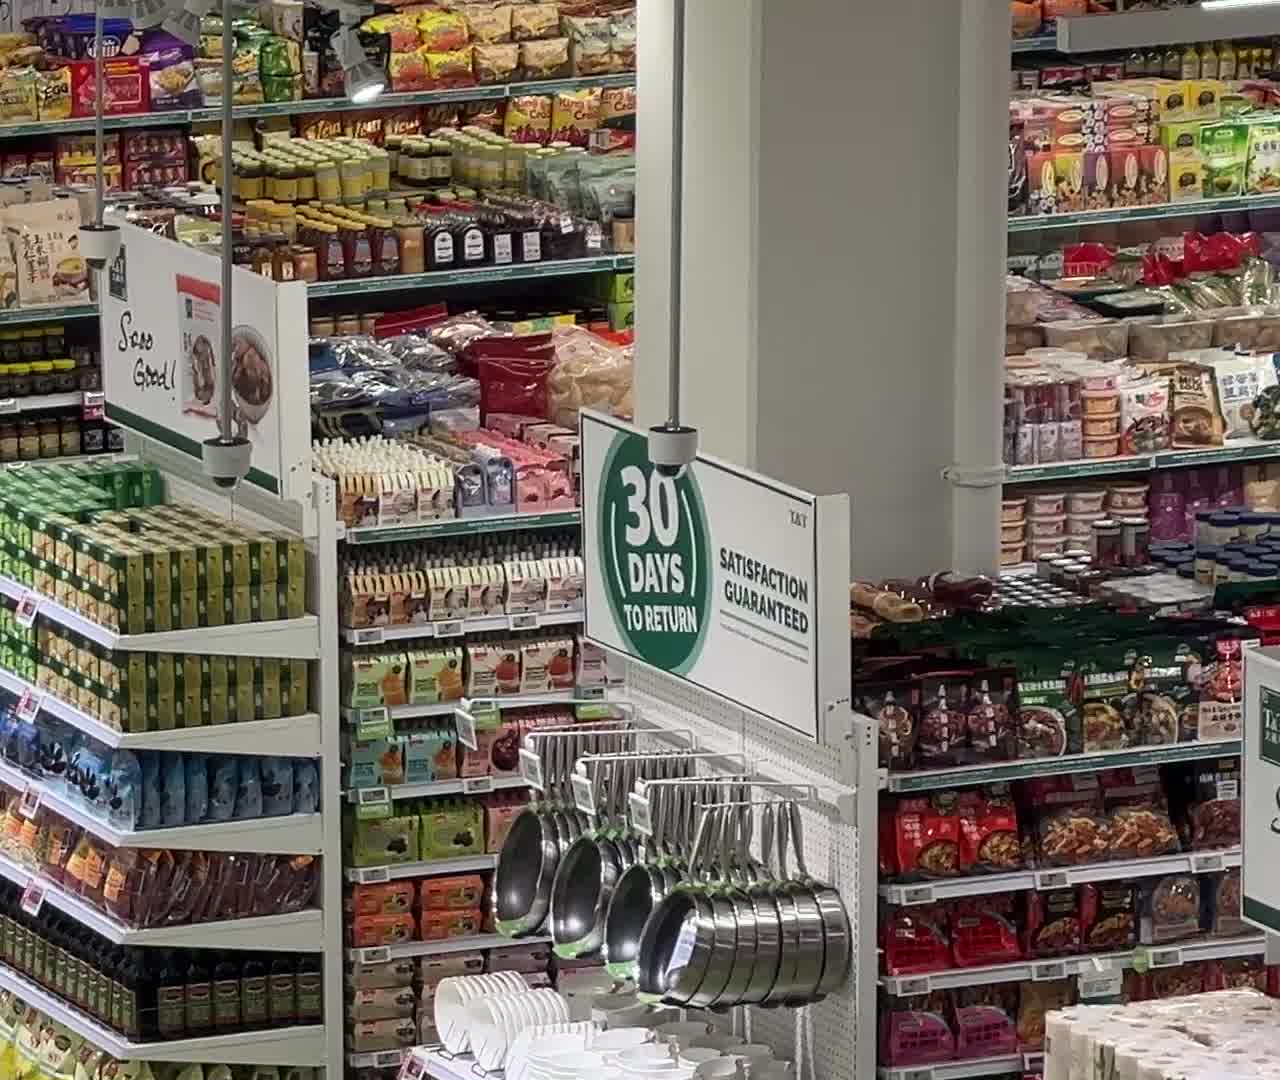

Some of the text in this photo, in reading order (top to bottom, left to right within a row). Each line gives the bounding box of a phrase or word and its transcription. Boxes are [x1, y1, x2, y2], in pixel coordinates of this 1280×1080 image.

[118, 311, 154, 351] Sooo
[133, 357, 177, 401] Good!
[620, 464, 680, 547] 30
[628, 551, 685, 595] DAYS
[719, 546, 809, 604] SATISFACTION
[624, 604, 698, 634] TO RETURN
[724, 579, 809, 635] GUARANTEED
